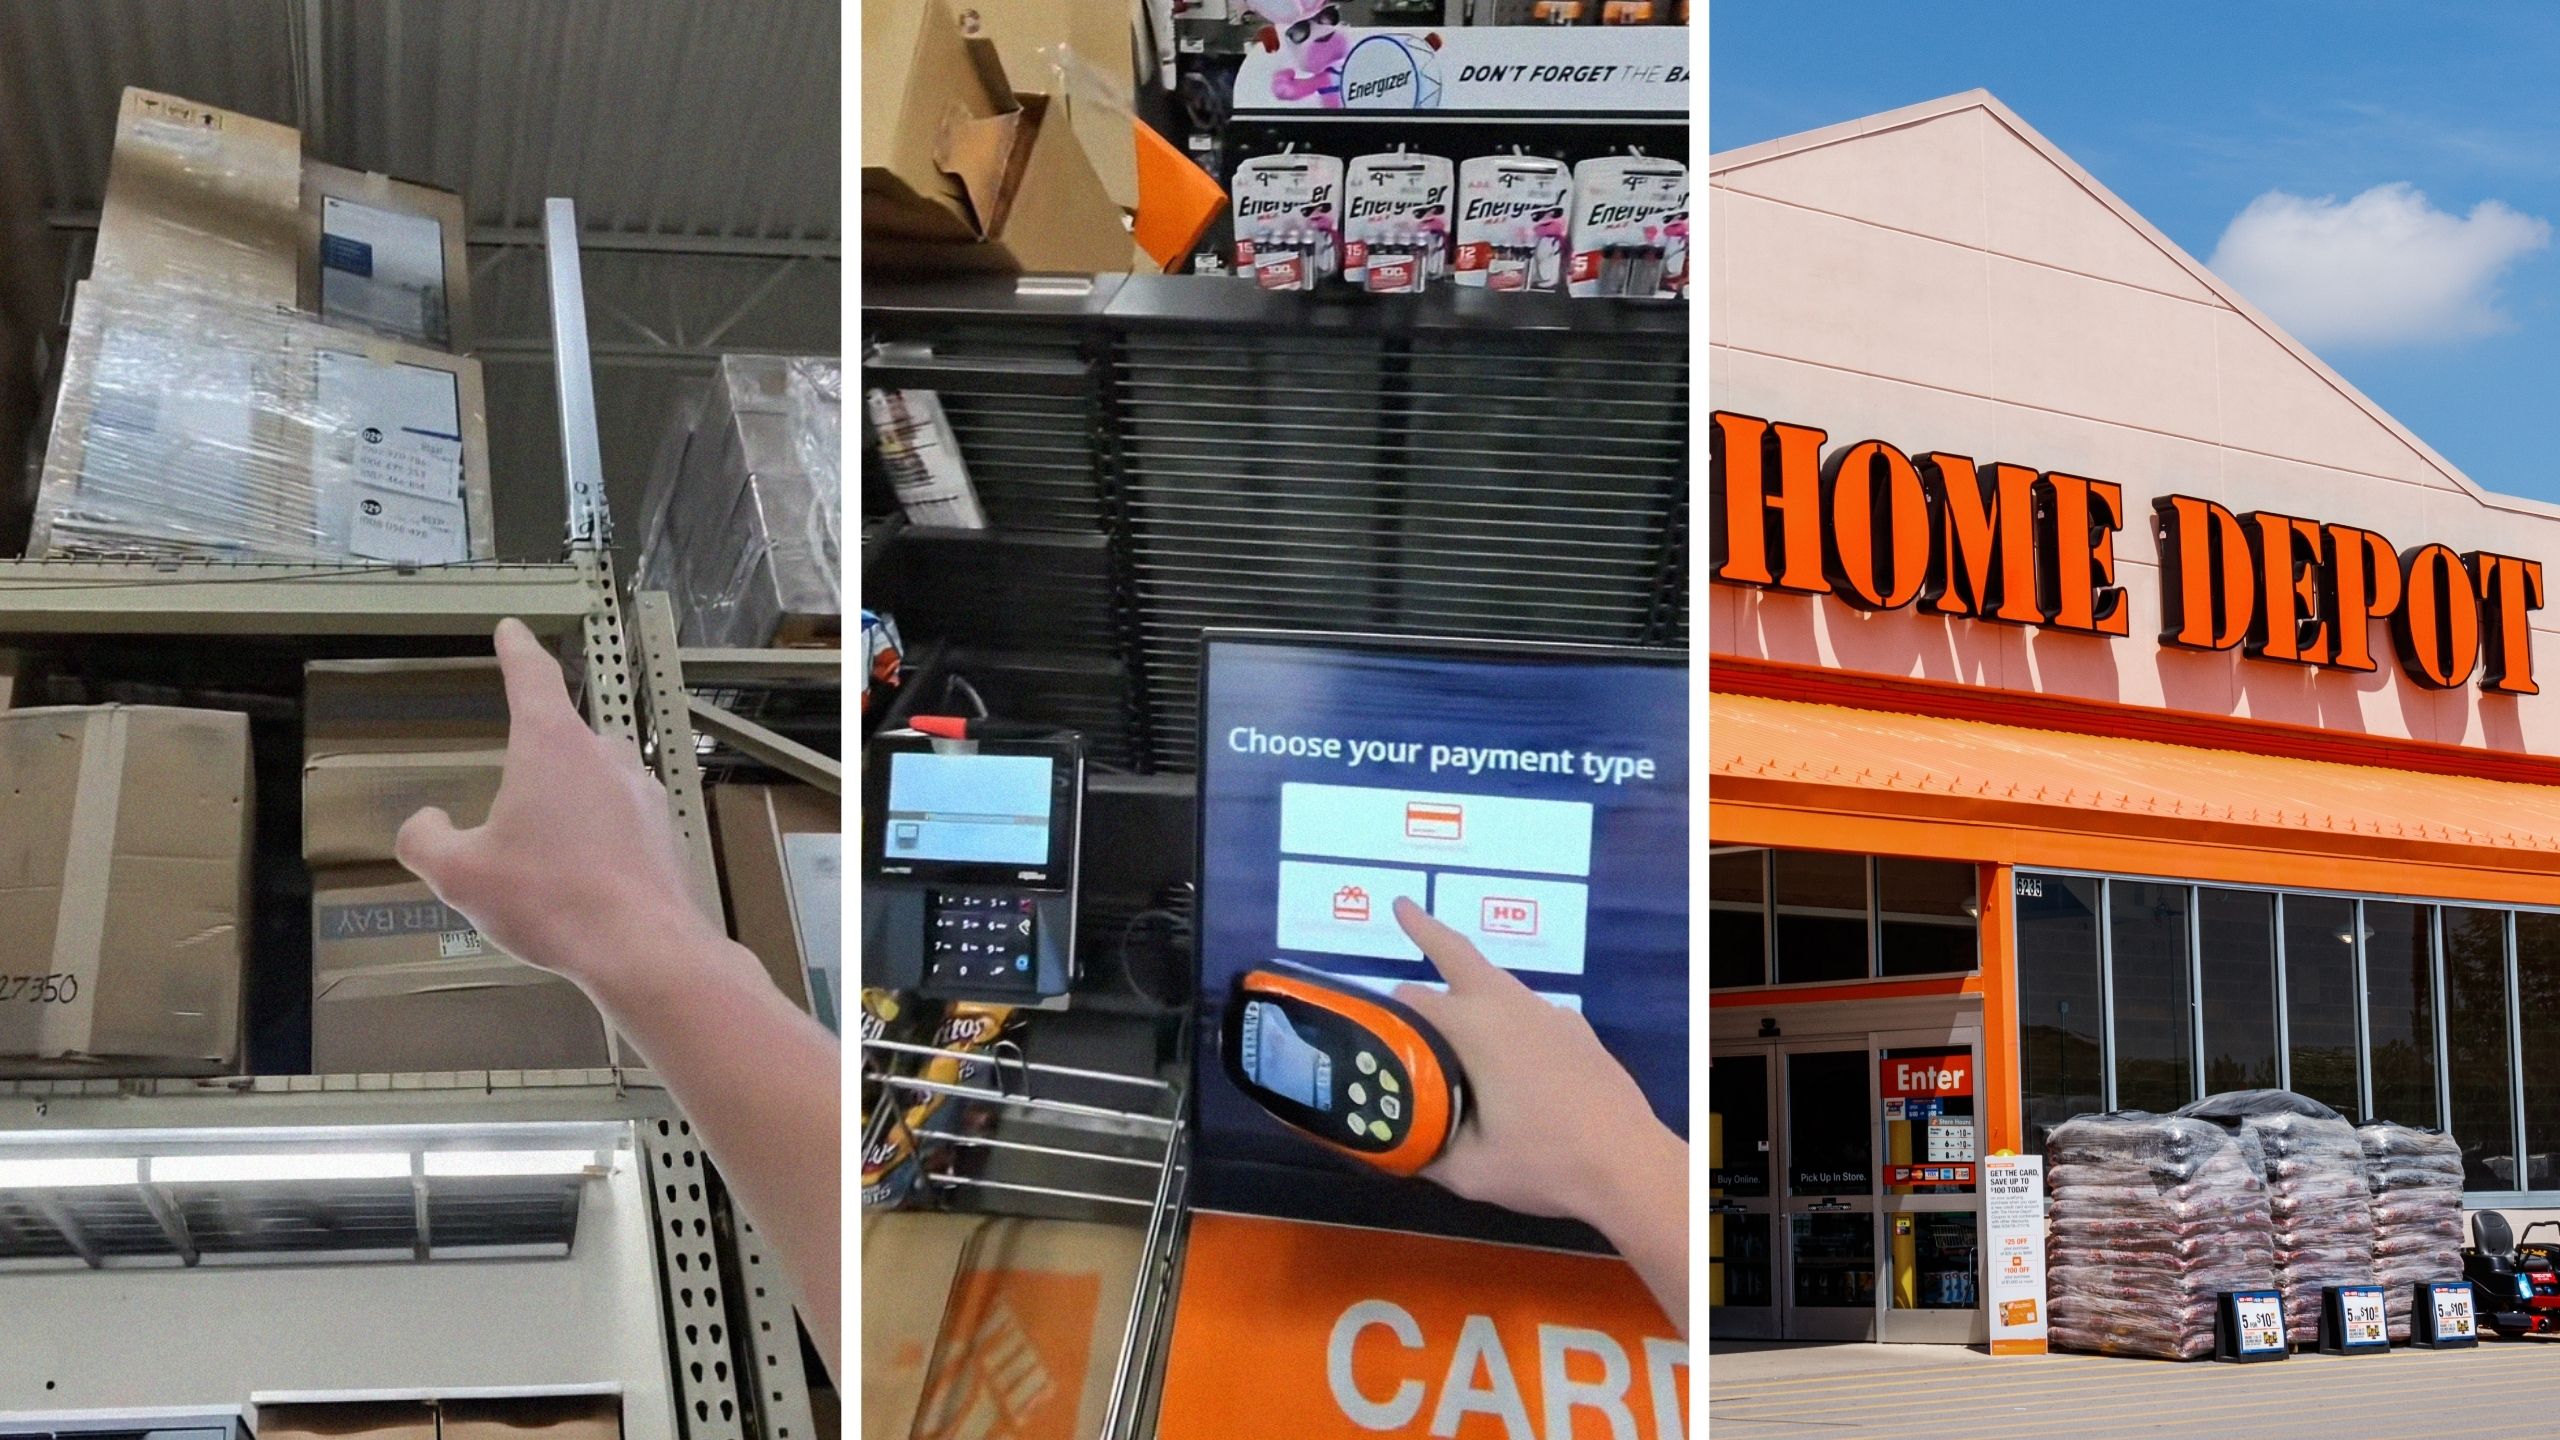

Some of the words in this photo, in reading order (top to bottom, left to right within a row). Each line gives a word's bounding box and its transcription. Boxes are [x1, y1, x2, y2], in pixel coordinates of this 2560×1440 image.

[1459, 66, 1526, 82] DON'T
[1529, 66, 1617, 82] FORGET
[1621, 65, 1663, 82] THE
[1348, 70, 1412, 102] Energizer
[1459, 247, 1475, 258] 12
[1711, 410, 2130, 638] HOME
[2153, 494, 2543, 696] DEPOT
[1229, 727, 1341, 758] Choose
[1349, 739, 1422, 766] your
[1431, 743, 1574, 775] payment
[1582, 751, 1656, 784] type
[2017, 878, 2041, 896] 6235
[337, 906, 394, 932] BAY
[1493, 906, 1527, 921] HD
[1898, 1064, 1965, 1091] Enter
[1717, 1175, 1732, 1185] Buy
[1734, 1174, 1760, 1184] Online.
[1801, 1173, 1818, 1182] Pick
[1820, 1173, 1831, 1183] Up
[1833, 1172, 1841, 1181] In
[1842, 1172, 1866, 1181] Store.
[2347, 1308, 2353, 1321] 5
[2360, 1307, 2374, 1320] $10
[2438, 1304, 2444, 1317] 5
[2450, 1303, 2463, 1316] $10
[2242, 1315, 2248, 1328] 5
[2256, 1313, 2271, 1327] $10
